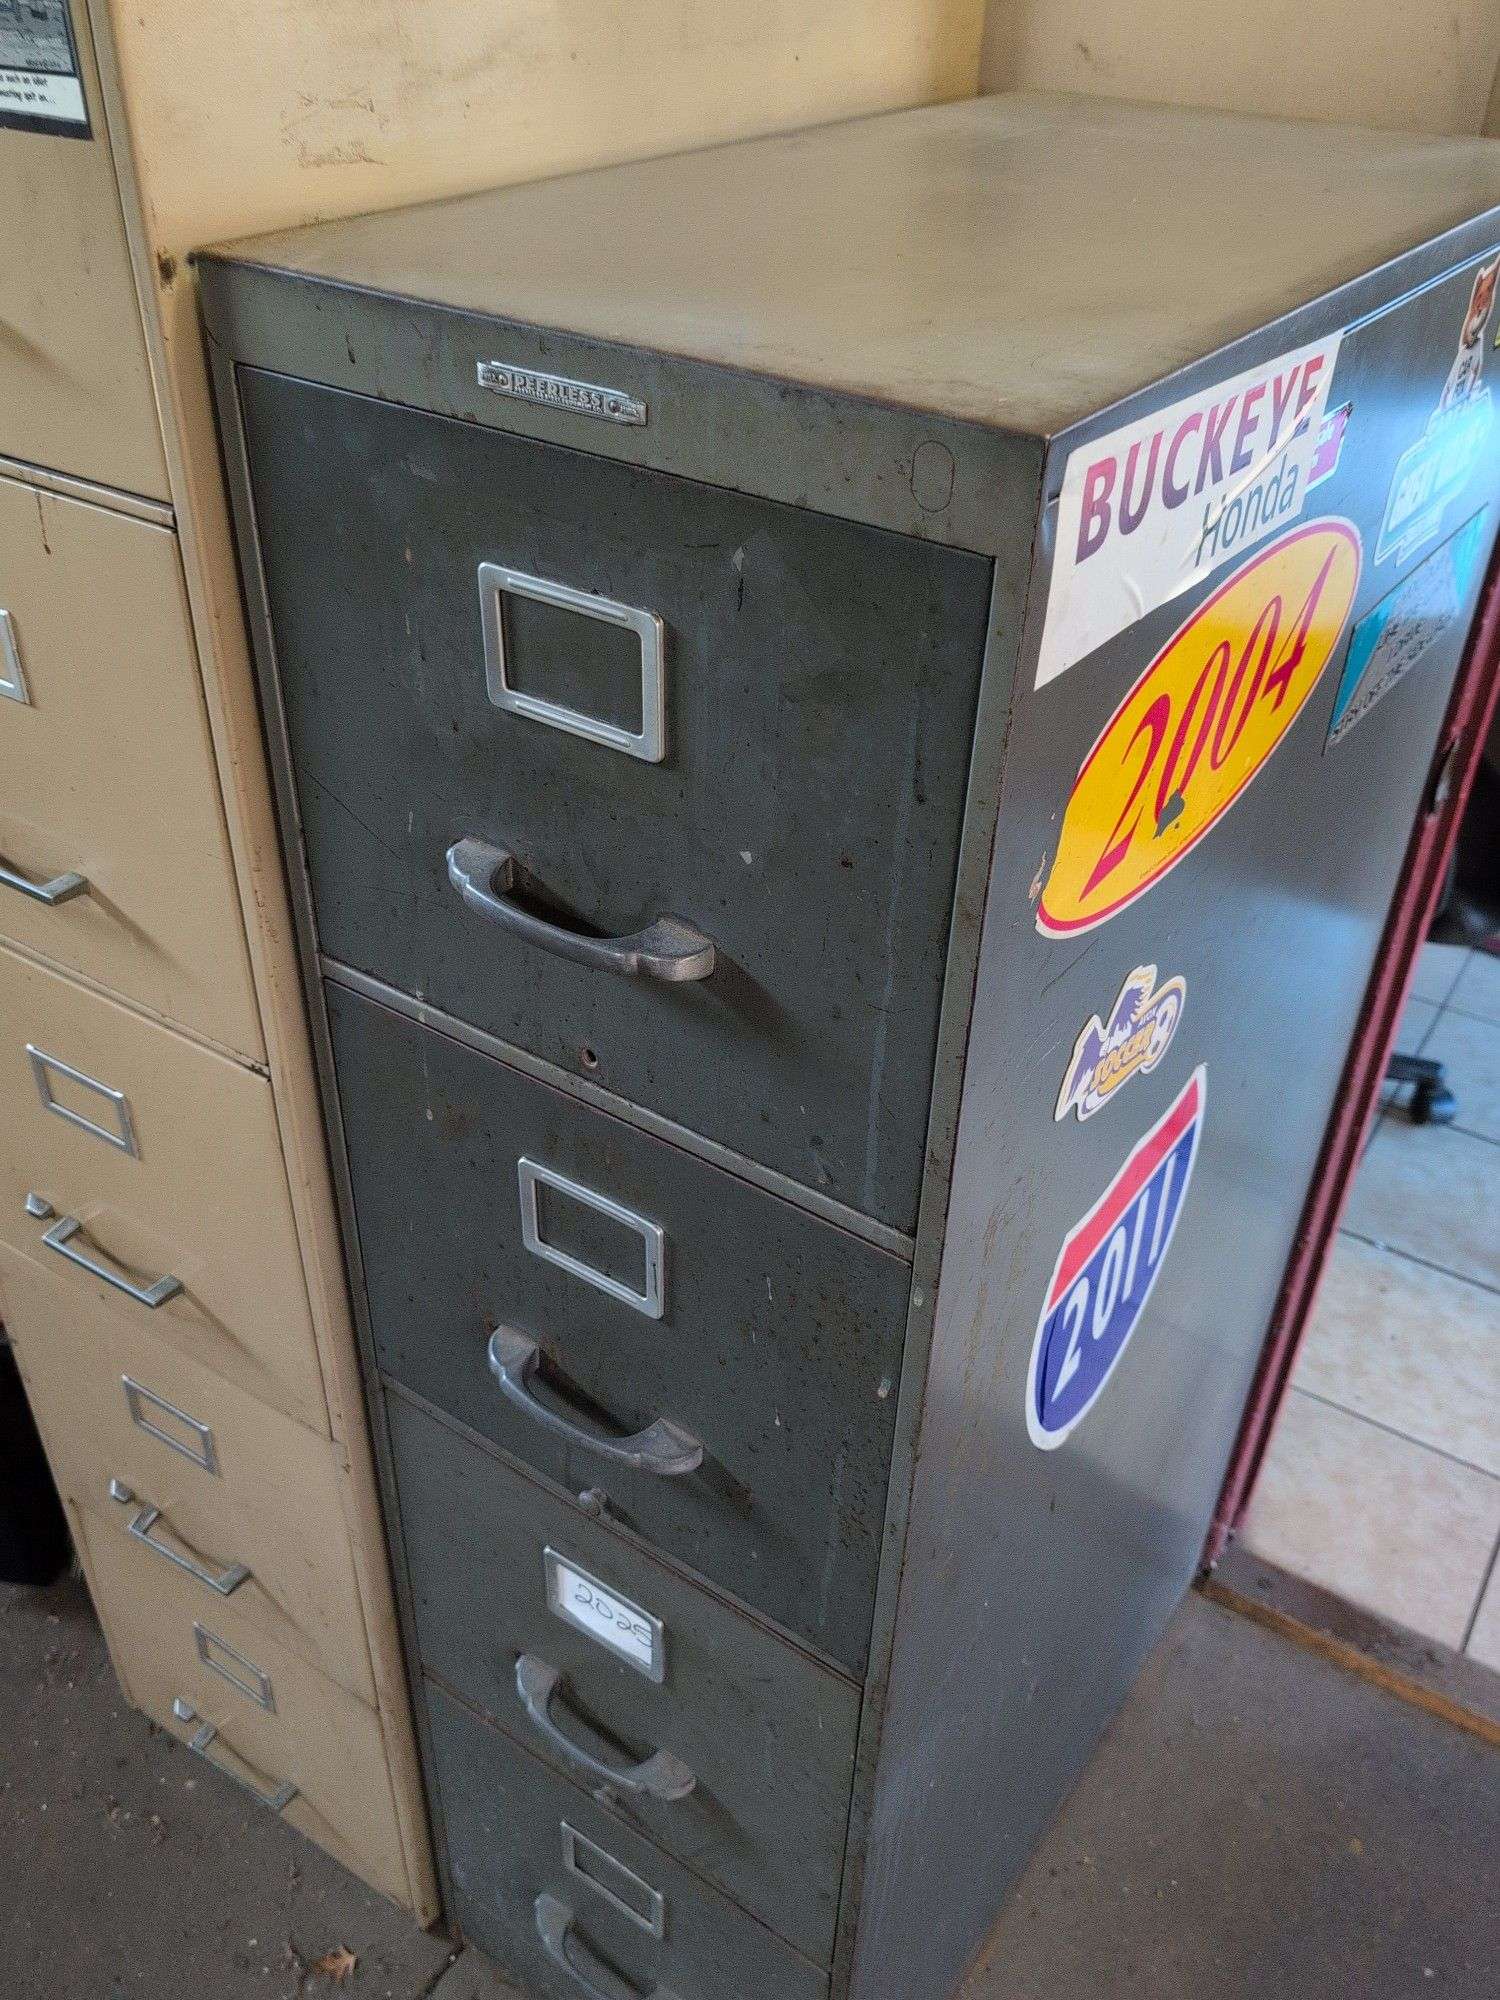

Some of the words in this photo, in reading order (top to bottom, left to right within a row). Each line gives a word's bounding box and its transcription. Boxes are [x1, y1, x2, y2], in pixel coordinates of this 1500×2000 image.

[514, 374, 603, 406] PEERLESS
[1075, 354, 1324, 566] BUCKEYE
[1194, 453, 1299, 568] Honda
[1079, 544, 1337, 902] 2004
[1051, 1152, 1177, 1402] 2011
